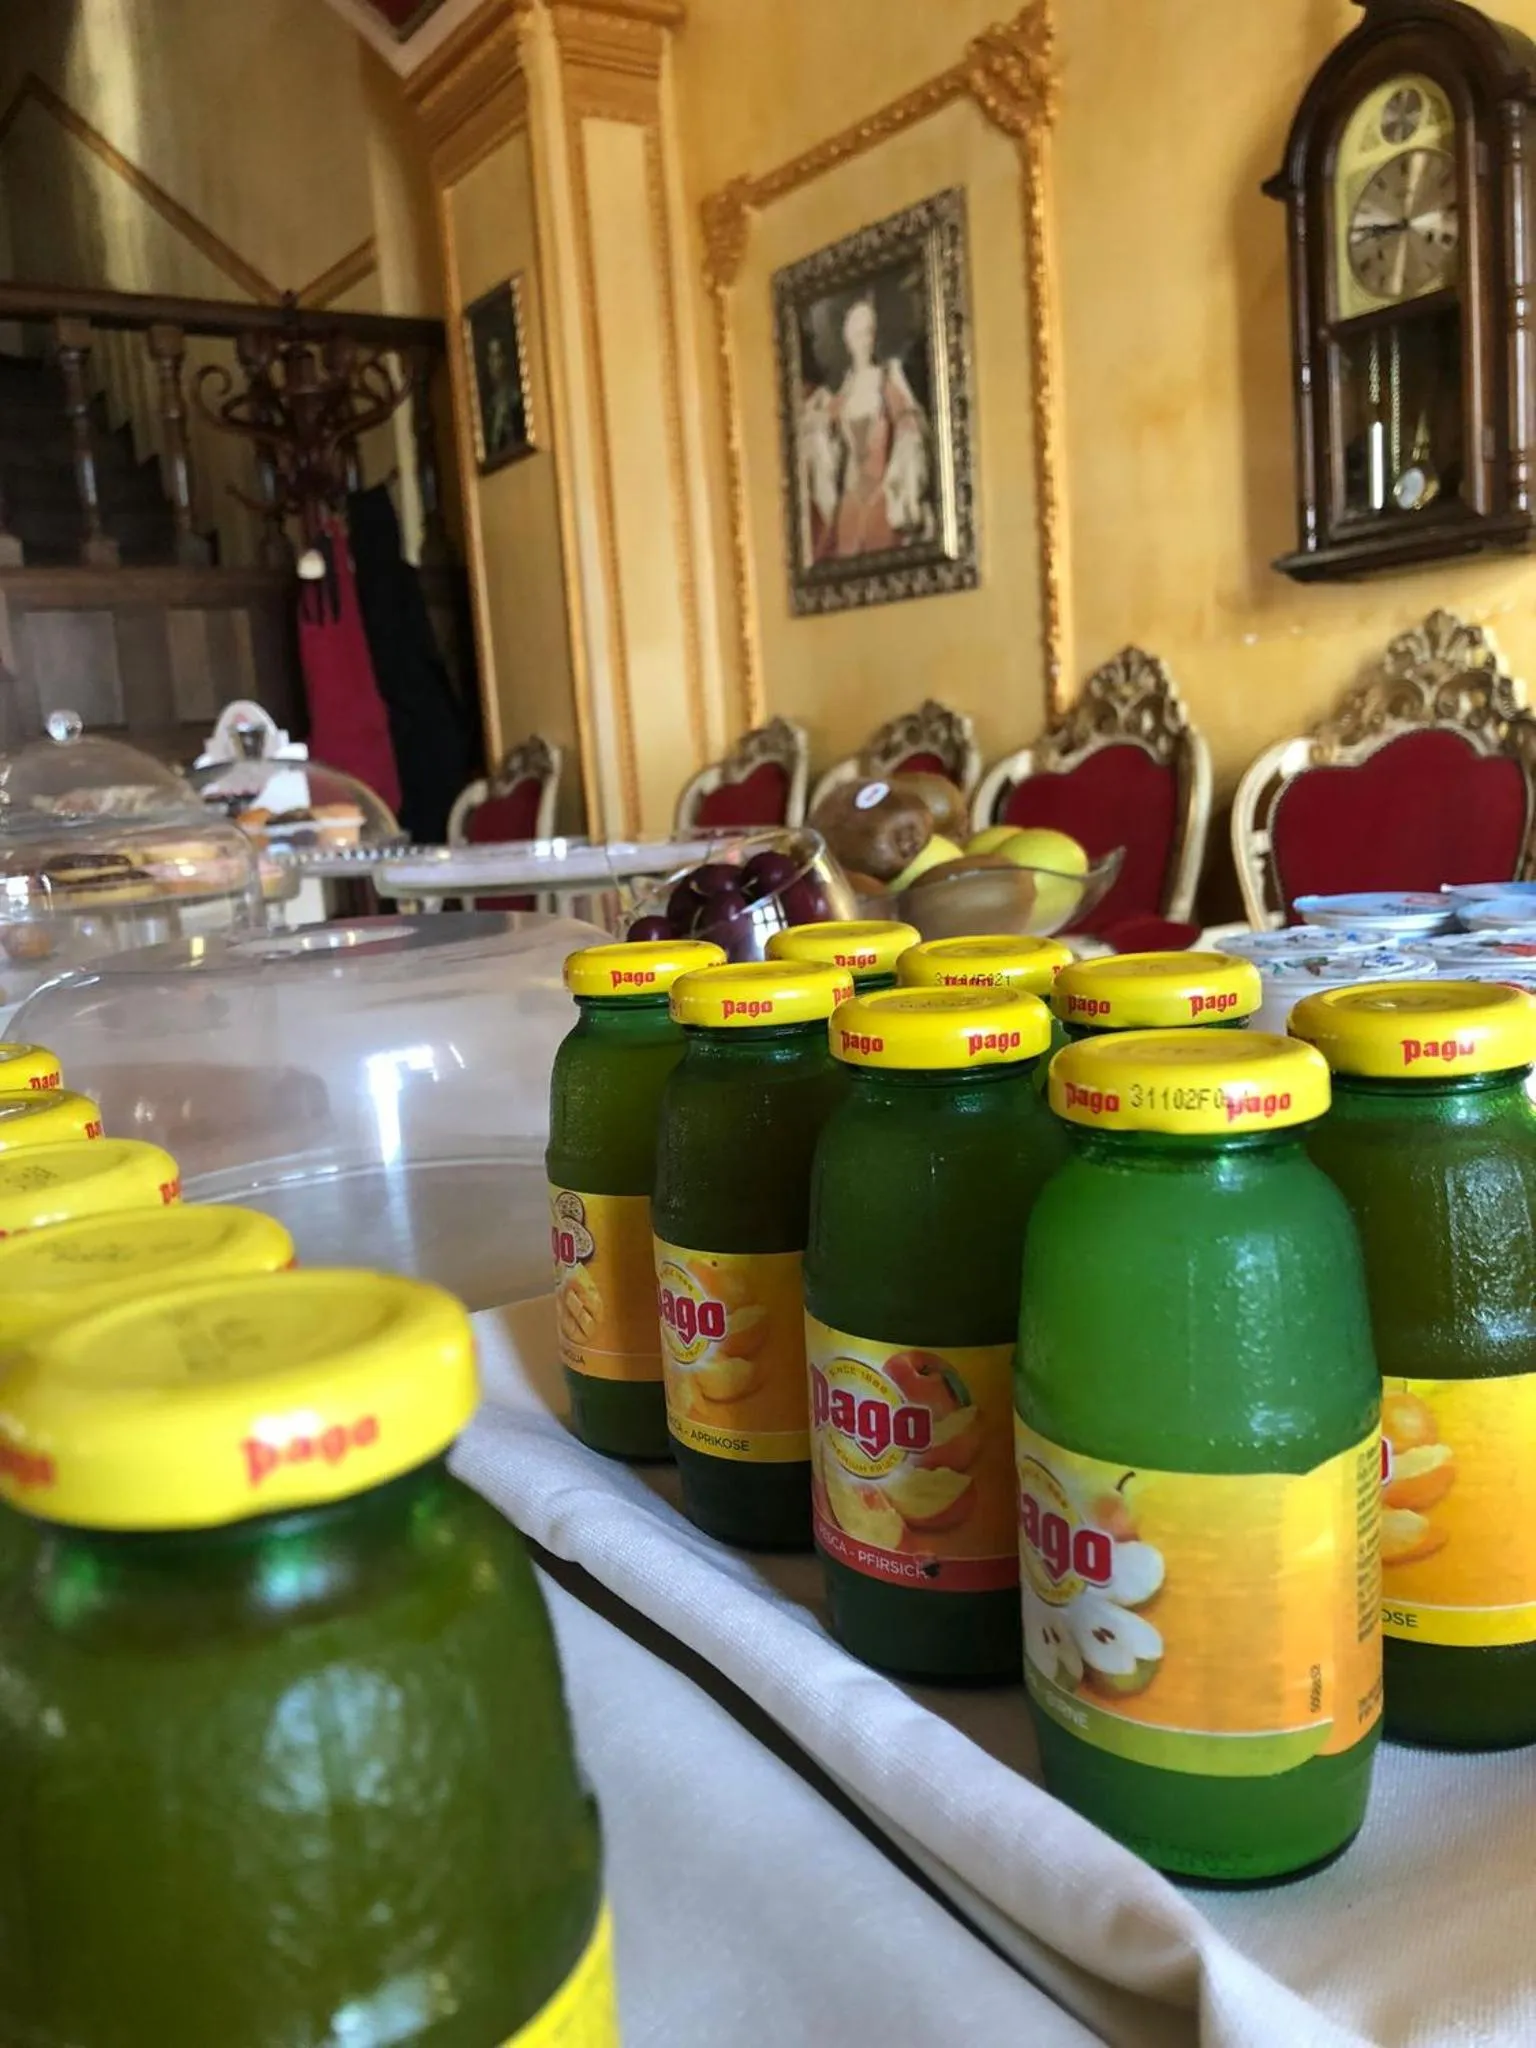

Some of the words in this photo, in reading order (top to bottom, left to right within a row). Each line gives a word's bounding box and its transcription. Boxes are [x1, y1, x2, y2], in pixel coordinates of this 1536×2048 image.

[610, 970, 656, 988] pago
[721, 998, 774, 1020] pago
[1067, 994, 1111, 1017] pago
[1188, 992, 1238, 1018] pago
[840, 1030, 884, 1055] pago
[968, 1031, 1021, 1056] pago
[1064, 1082, 1120, 1115] pago
[1226, 1092, 1292, 1122] pago
[658, 1287, 726, 1346] ago
[809, 1361, 932, 1458] pago
[241, 1415, 379, 1489] pago
[690, 1428, 750, 1452] APRIKOSE
[1019, 1493, 1113, 1584] ago
